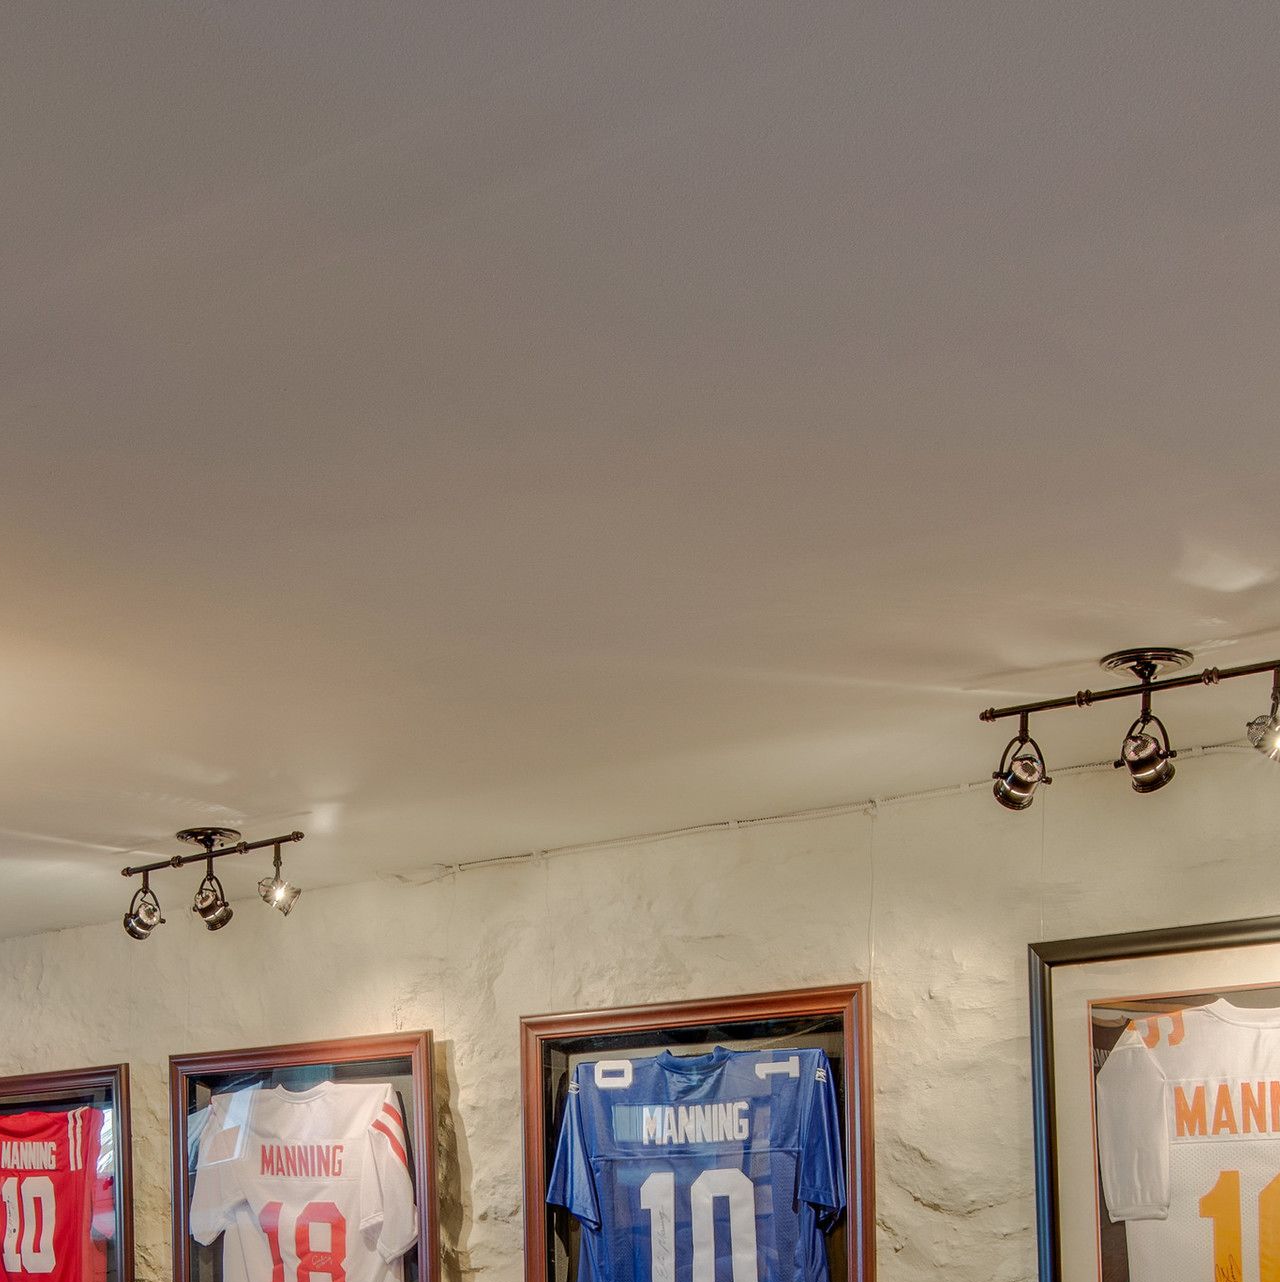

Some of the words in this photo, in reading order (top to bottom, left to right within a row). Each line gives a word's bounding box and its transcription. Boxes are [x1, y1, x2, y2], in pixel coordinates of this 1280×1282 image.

[594, 1059, 634, 1089] 0
[755, 1055, 801, 1080] 1
[642, 1101, 750, 1146] MANNING
[1, 1141, 56, 1170] MANNING
[259, 1143, 344, 1178] MANNING
[1, 1176, 56, 1273] 10
